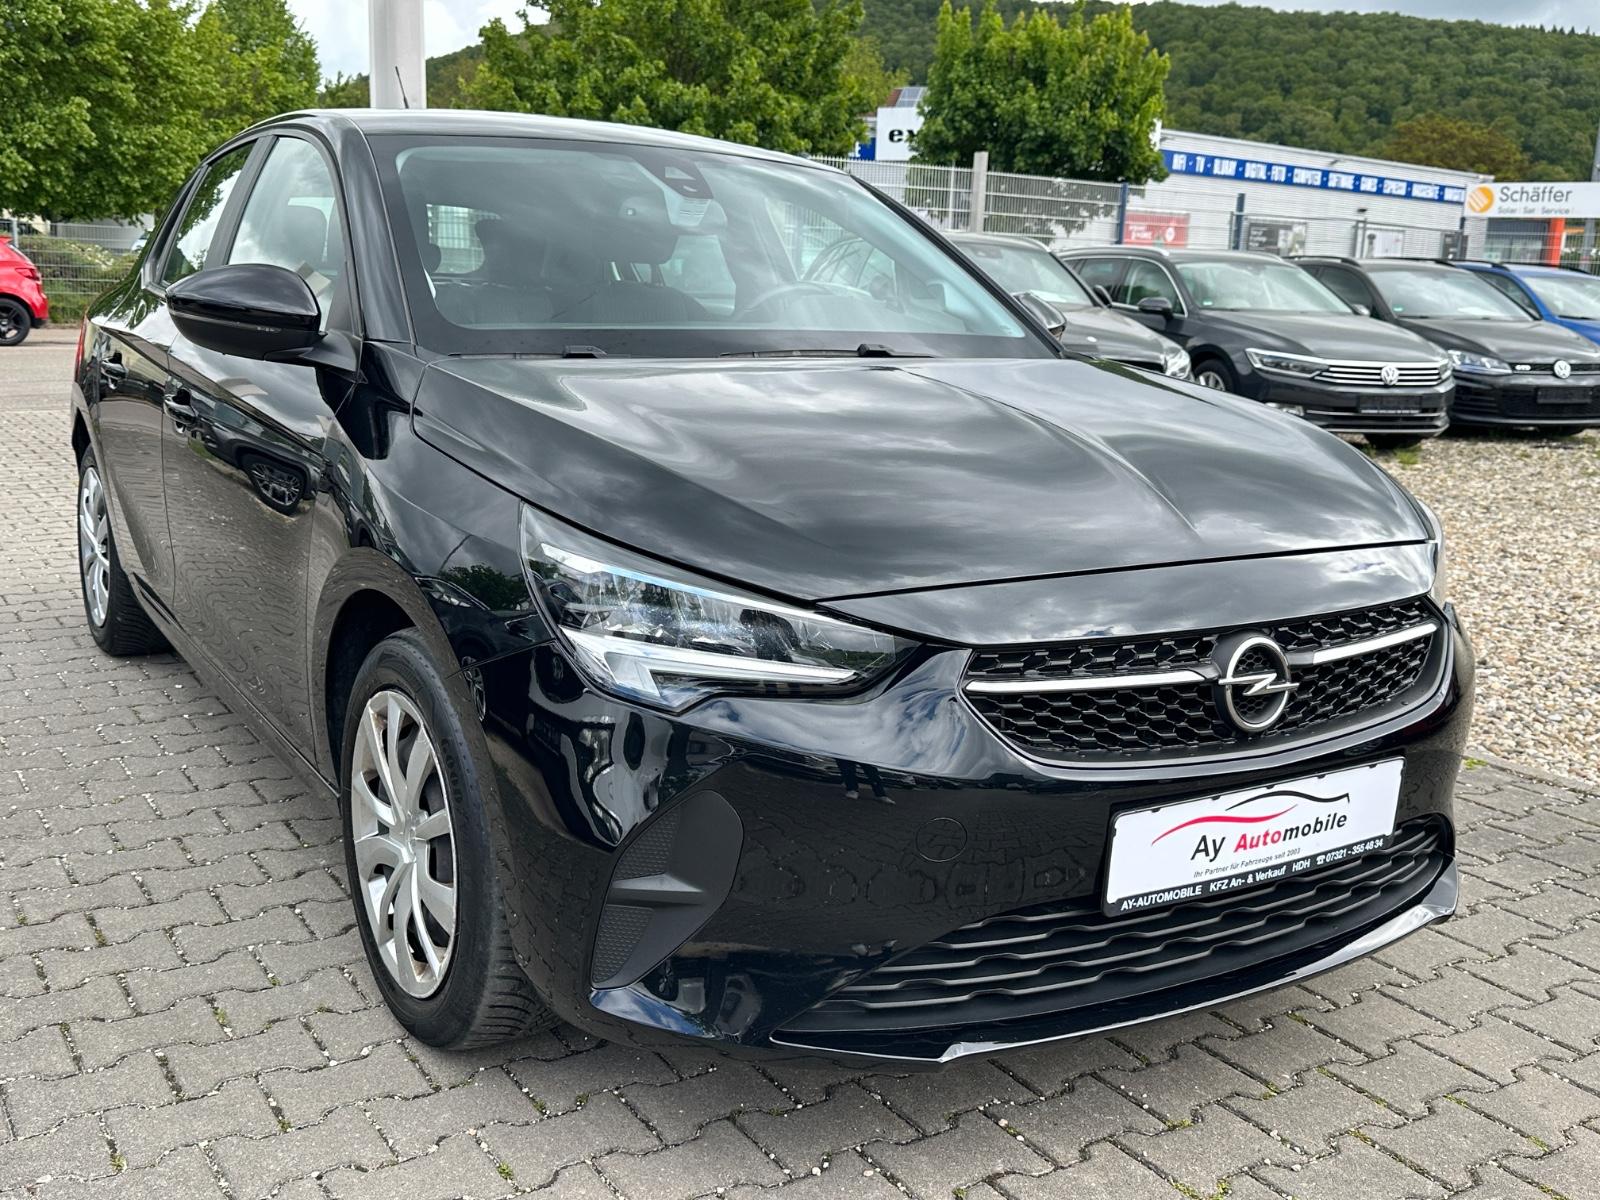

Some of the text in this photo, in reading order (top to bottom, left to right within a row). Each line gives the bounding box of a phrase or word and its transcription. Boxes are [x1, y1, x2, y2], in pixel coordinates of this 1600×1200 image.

[1499, 186, 1572, 203] Schäffer
[1541, 206, 1570, 215] Service
[1190, 813, 1348, 863] Ay Automobile
[1204, 866, 1229, 876] Partner
[1240, 855, 1273, 868] Fahrzeuge
[1274, 850, 1286, 860] seit
[1120, 885, 1203, 911] AY-AUTOMOBILE
[1209, 881, 1229, 893] KFZ
[1229, 878, 1245, 888] An-
[1246, 875, 1254, 884] &
[1255, 865, 1287, 882] Verkauf
[1292, 859, 1311, 872] HDH
[1325, 848, 1347, 862] 07321
